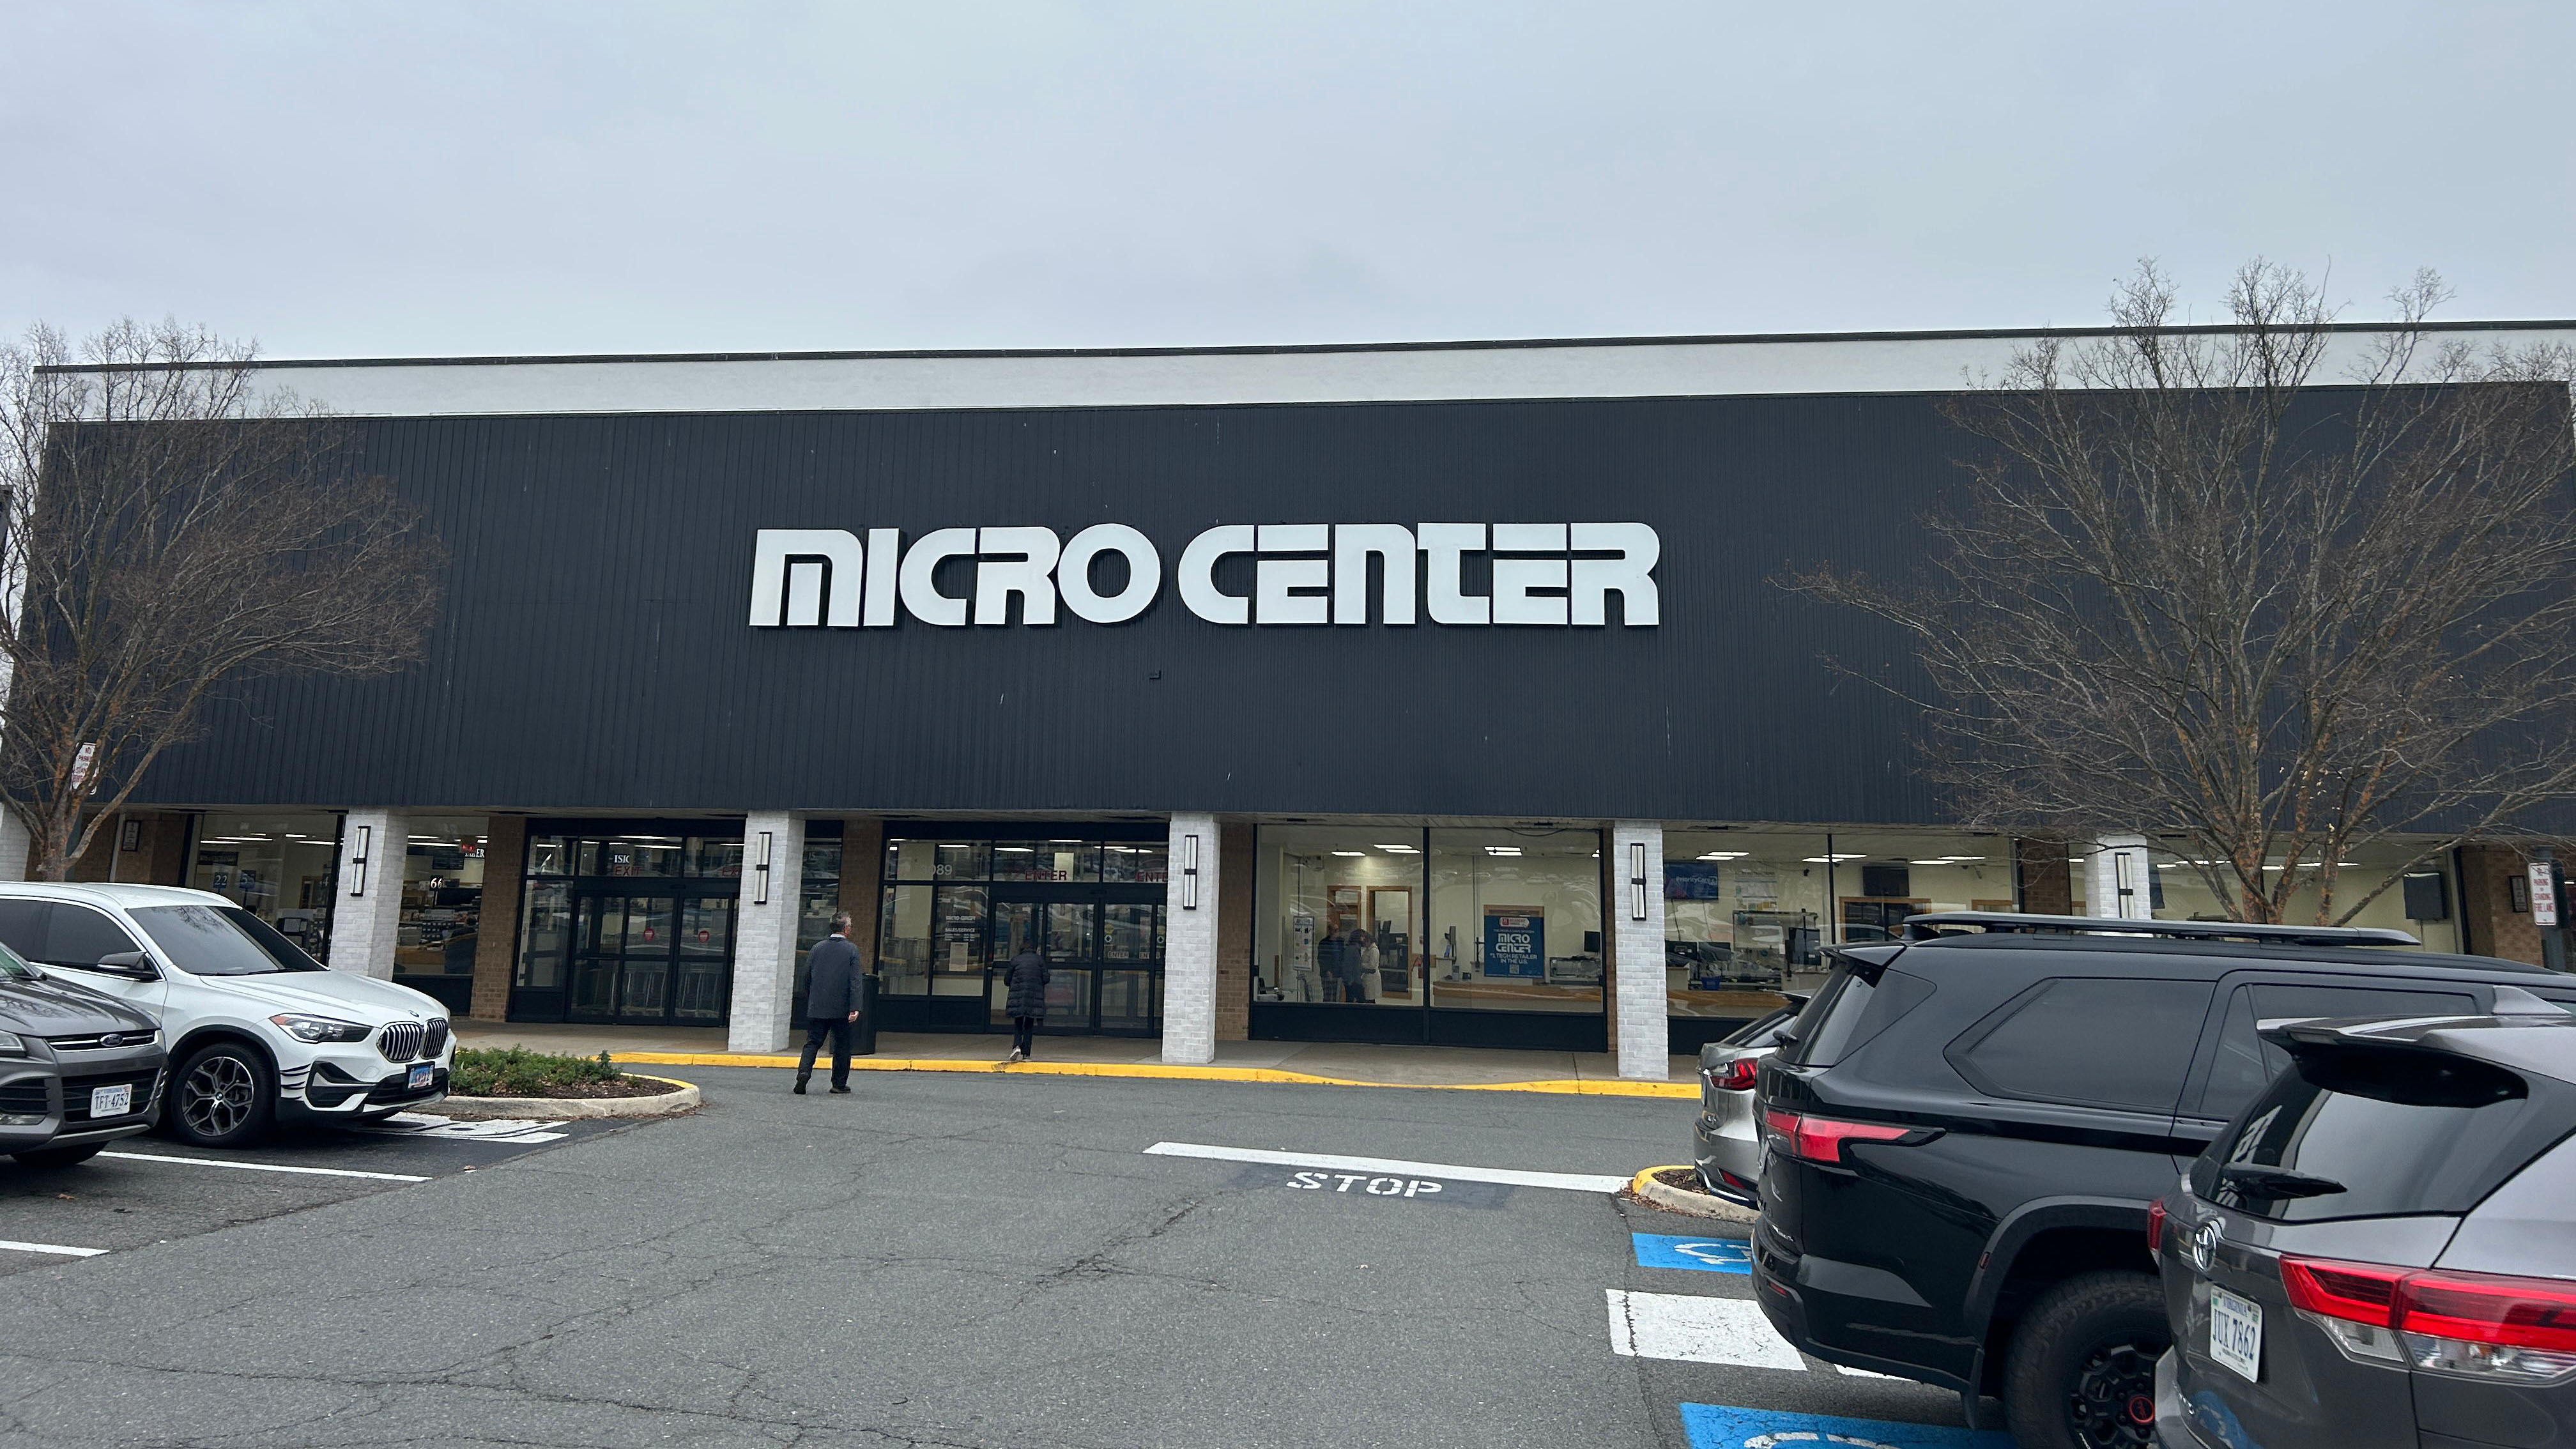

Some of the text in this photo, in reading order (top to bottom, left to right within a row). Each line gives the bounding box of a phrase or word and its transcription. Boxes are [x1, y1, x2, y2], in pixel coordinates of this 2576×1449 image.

[750, 523, 1659, 626] MICRO CENTER
[615, 866, 642, 877] EXIT
[722, 866, 741, 876] EXI
[1025, 870, 1067, 880] ENTER
[215, 875, 227, 885] 22
[1137, 871, 1168, 882] ENTE
[431, 878, 443, 888] 66
[1498, 933, 1530, 943] MICRO
[1496, 943, 1531, 953] CENTER
[1286, 1172, 1443, 1198] STOP
[2213, 1309, 2257, 1360] JUX 7862
